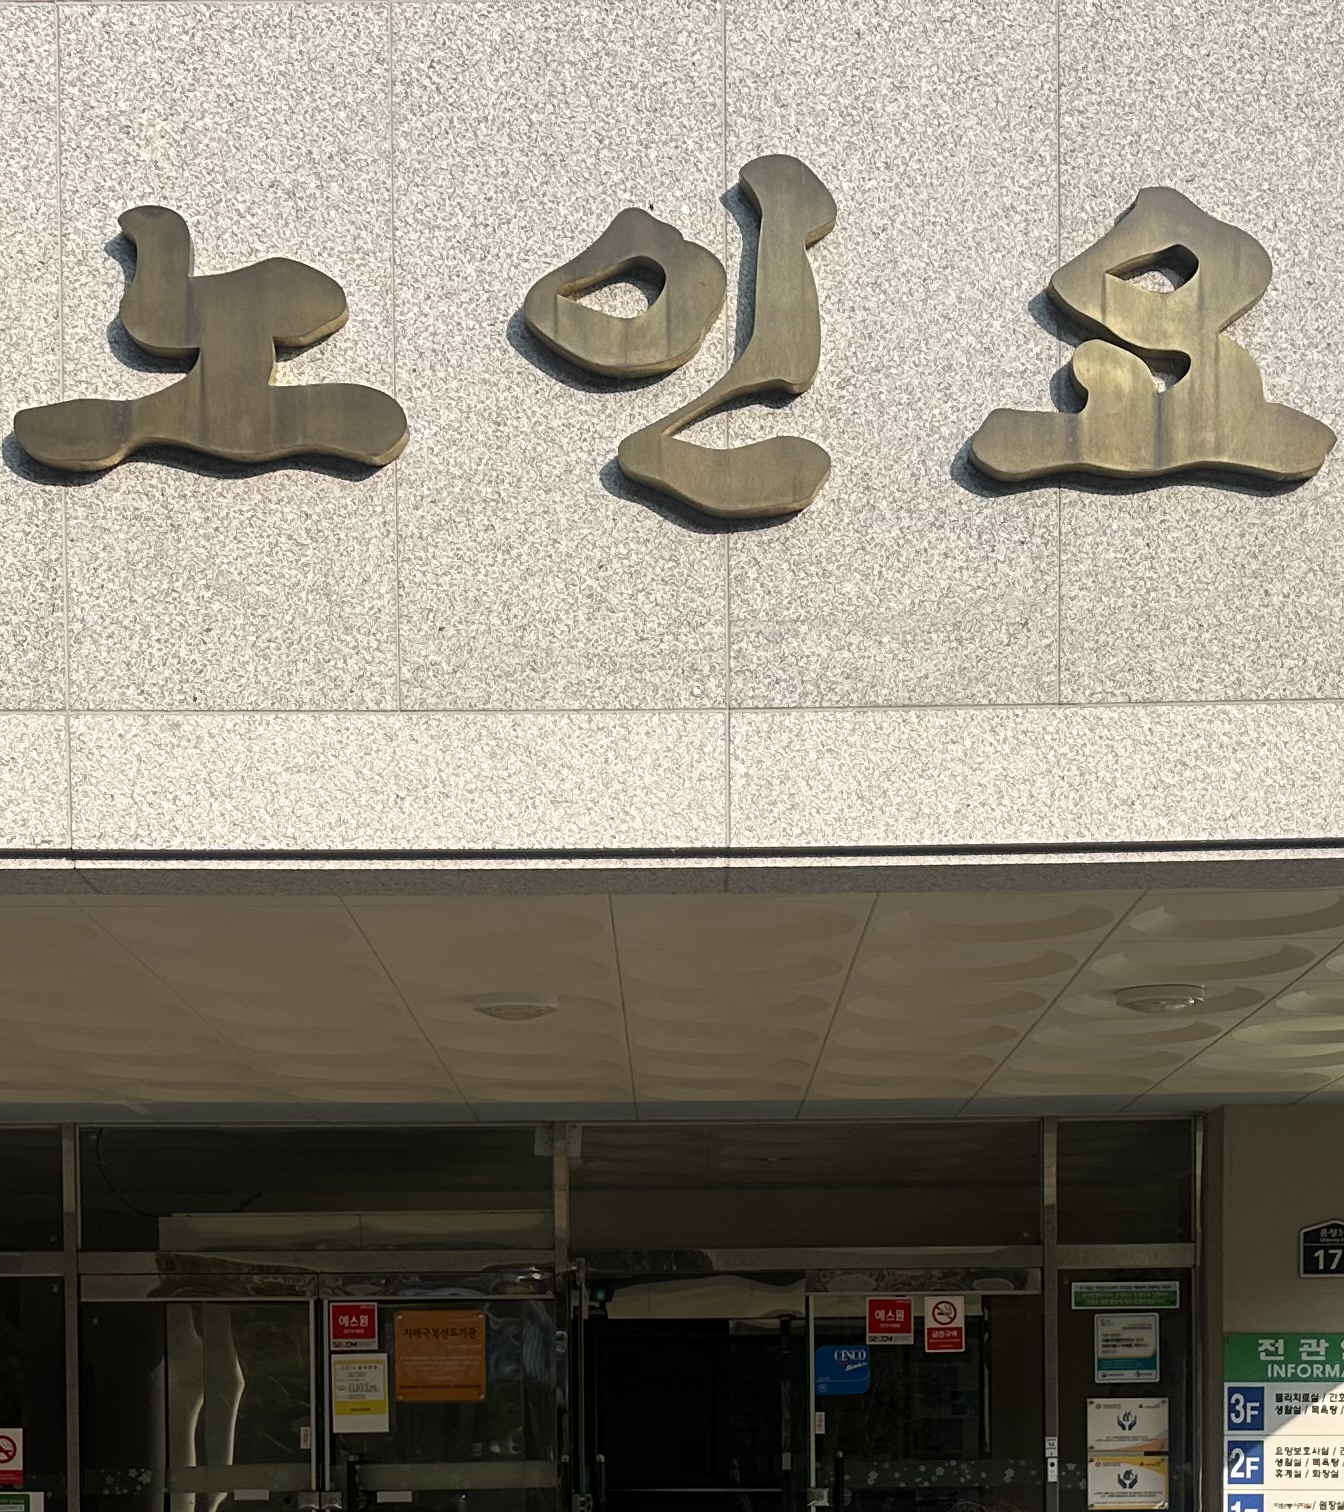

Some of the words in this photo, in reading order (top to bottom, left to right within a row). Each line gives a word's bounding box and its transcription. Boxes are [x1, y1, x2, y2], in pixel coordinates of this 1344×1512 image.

[875, 1309, 904, 1321] 에스원
[338, 1315, 368, 1327] 에스원
[1275, 1393, 1319, 1403] 물리치료실
[1230, 1393, 1260, 1423] 3F
[1275, 1405, 1301, 1415] 생활실
[1312, 1405, 1338, 1415] 목욕탕
[1275, 1447, 1329, 1456] 요양보호사실
[1230, 1448, 1260, 1479] 2F
[1275, 1458, 1301, 1467] 생활실
[1312, 1458, 1339, 1467] 목욕탕
[1275, 1469, 1301, 1478] 휴게실
[1312, 1469, 1339, 1478] 화장실
[1319, 1501, 1344, 1510] 원장실
